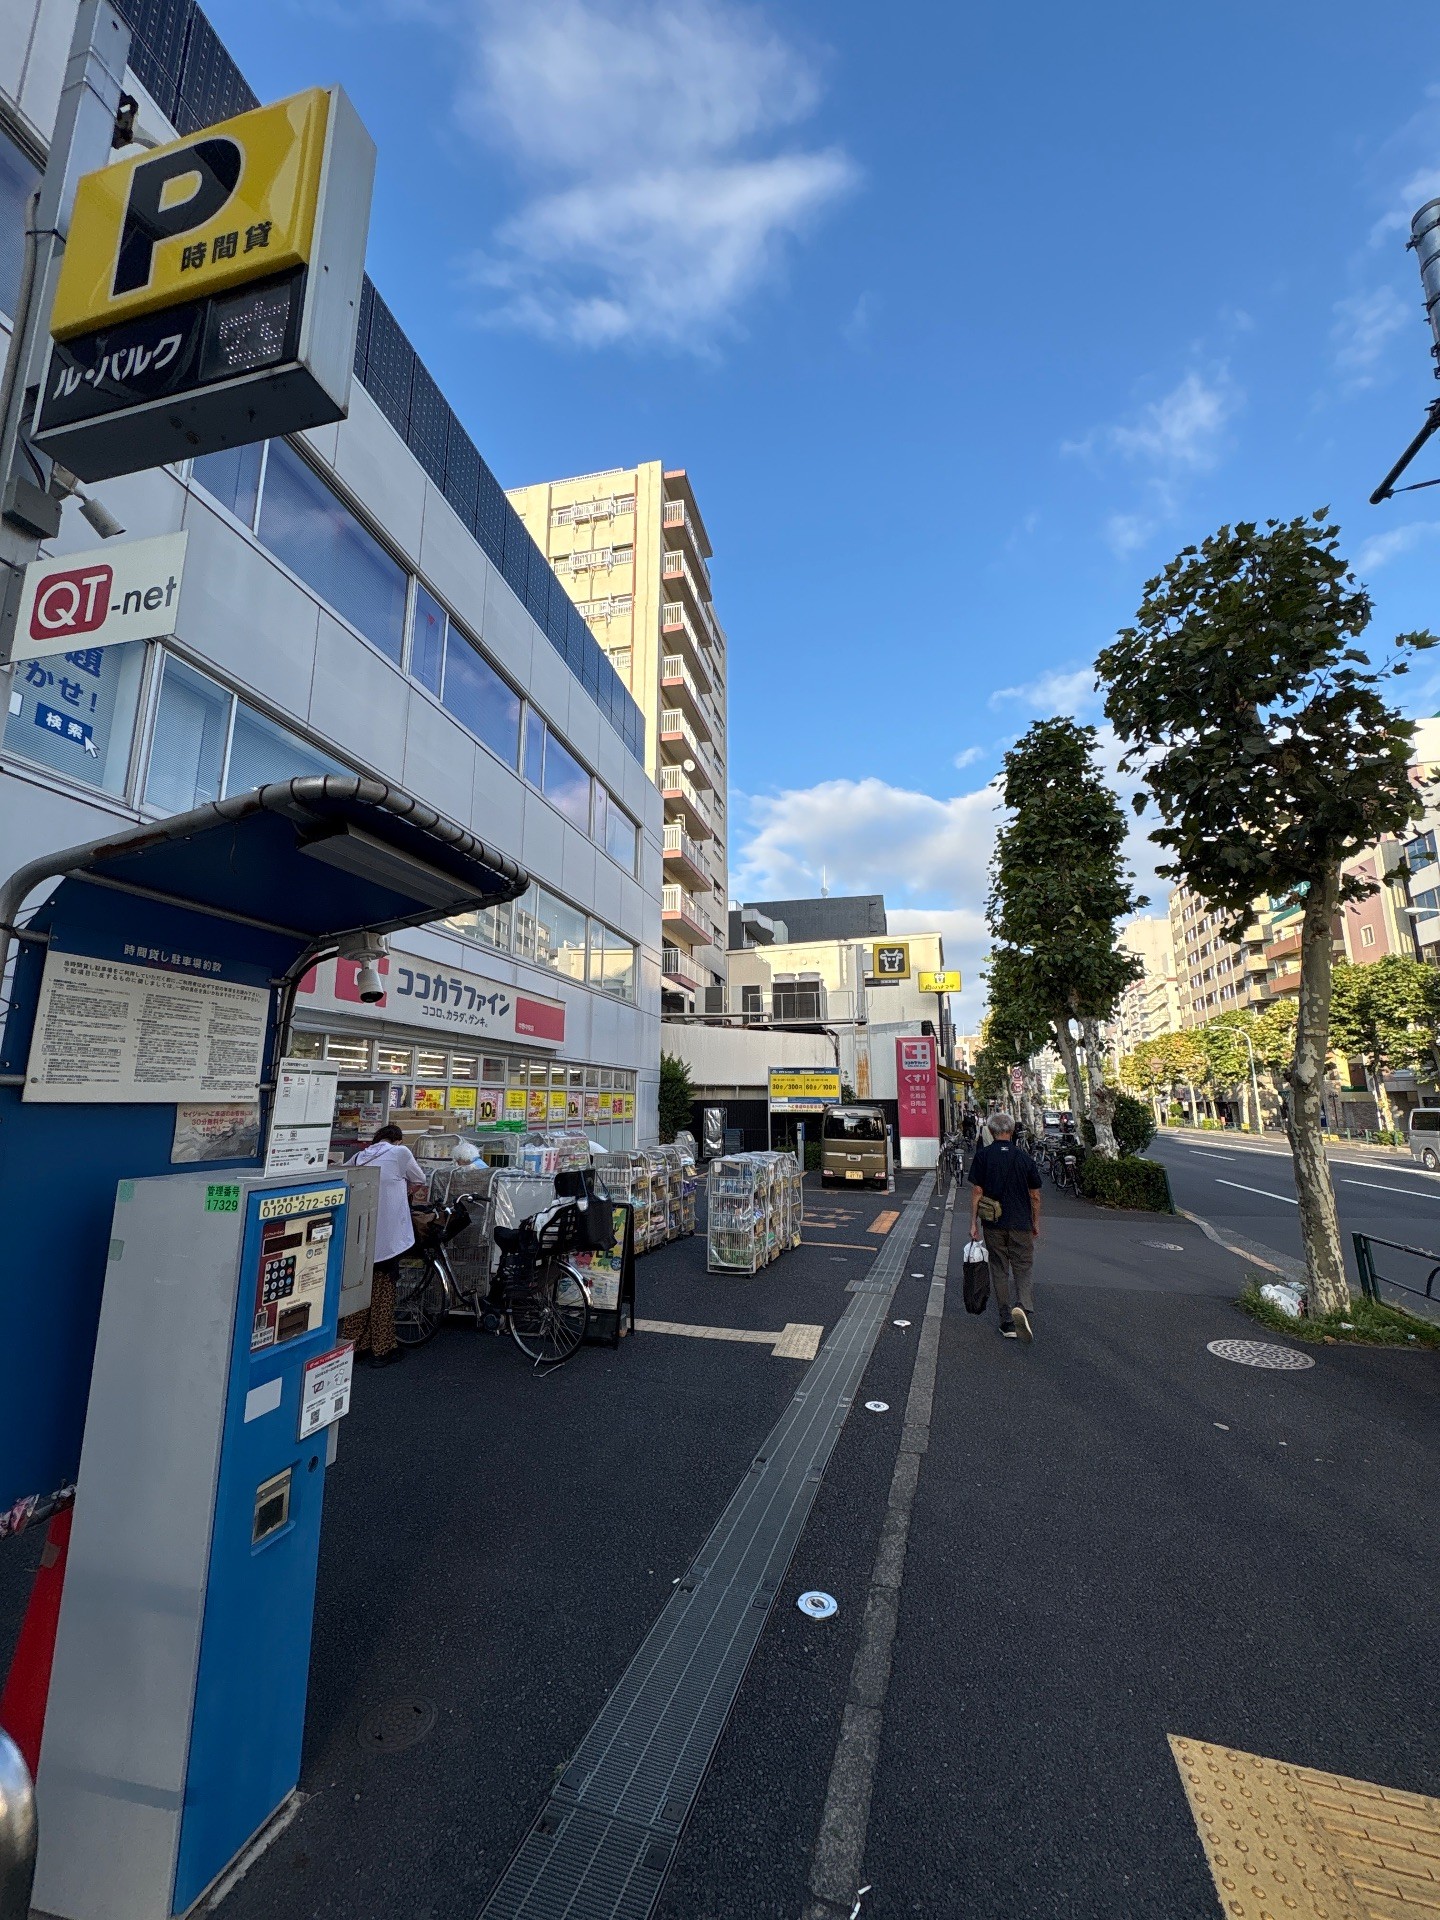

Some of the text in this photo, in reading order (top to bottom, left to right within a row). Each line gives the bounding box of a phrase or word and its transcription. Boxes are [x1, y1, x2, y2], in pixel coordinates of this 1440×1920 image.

[111, 138, 244, 298] P
[180, 220, 273, 273] 時間貸
[52, 333, 182, 401] ル・パルク
[37, 574, 177, 629] QT-net
[45, 711, 84, 740] 検索
[396, 967, 511, 1017] ココカラファイン
[904, 1074, 930, 1083] くすり
[207, 1185, 240, 1198] 管理番号
[207, 1199, 238, 1211] 17329
[262, 1193, 344, 1218] 0120-272-567
